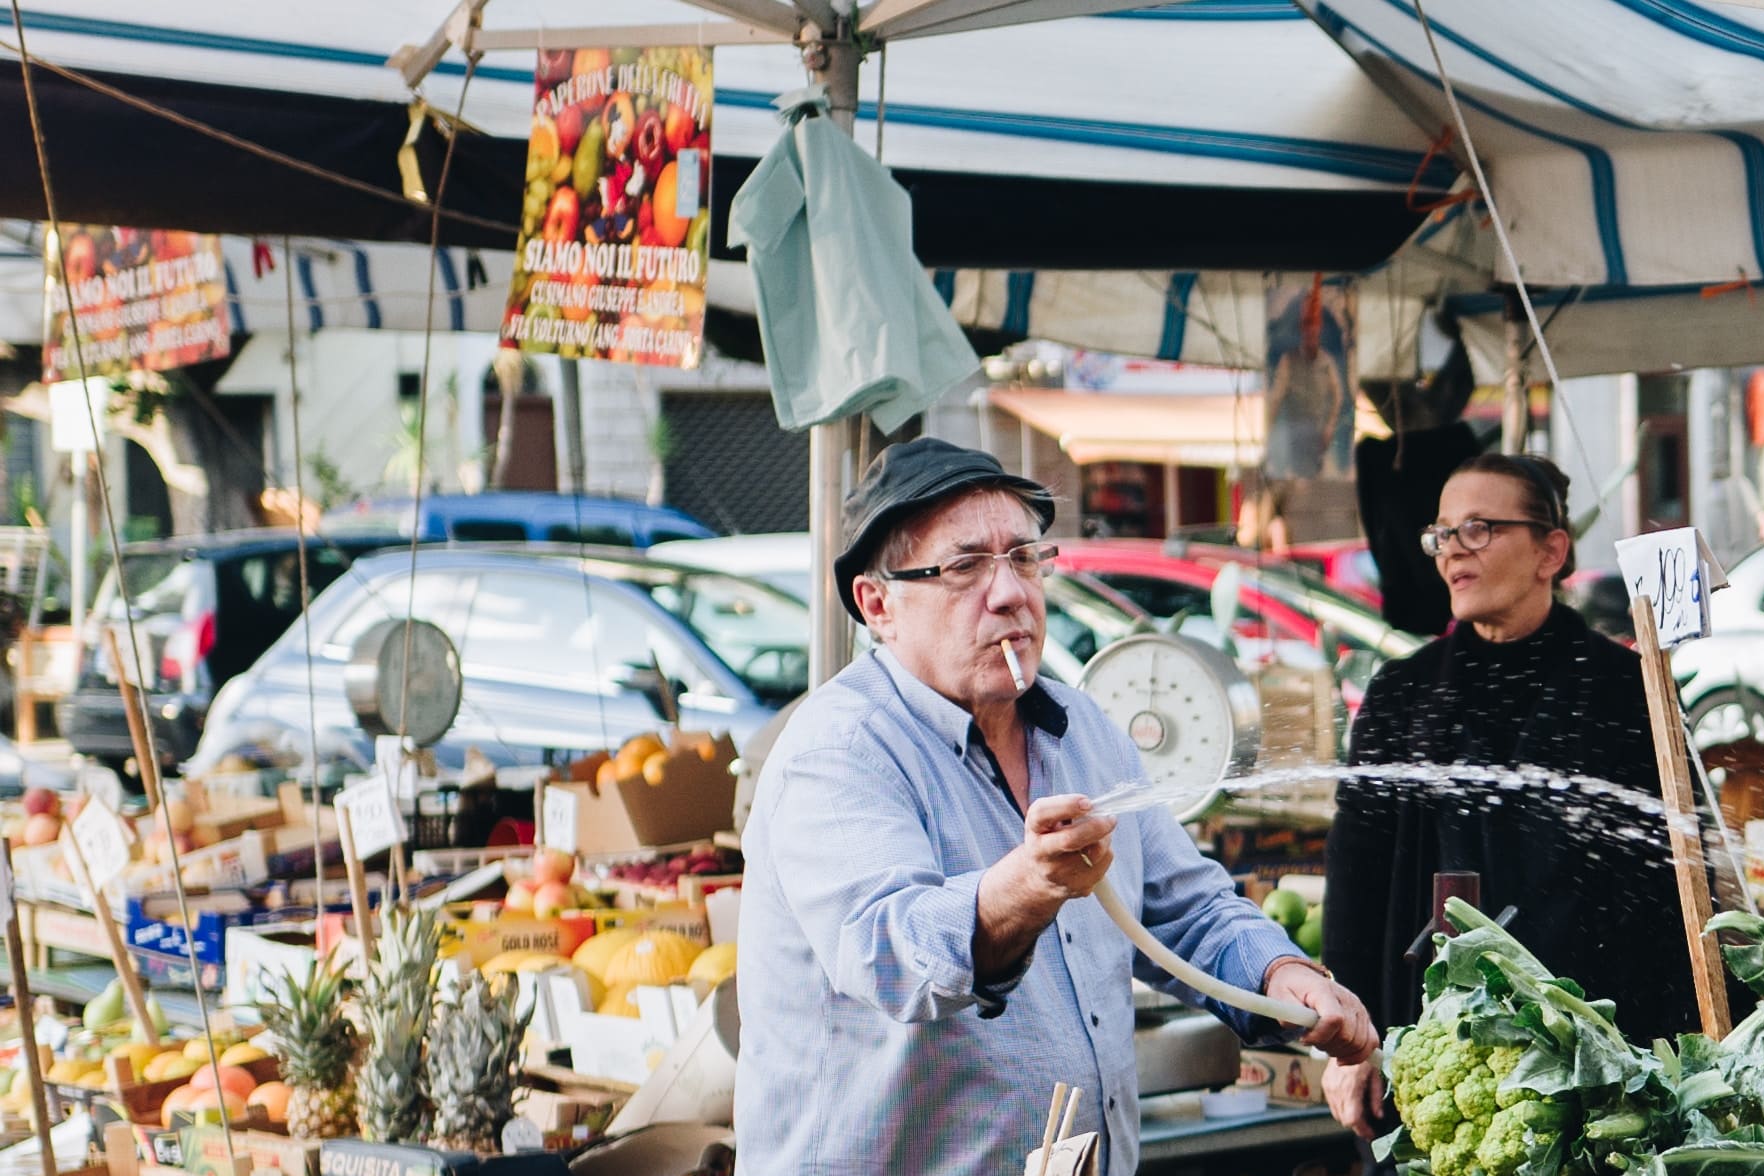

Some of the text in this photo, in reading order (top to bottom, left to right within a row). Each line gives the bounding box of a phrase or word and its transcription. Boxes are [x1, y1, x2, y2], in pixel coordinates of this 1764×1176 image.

[523, 239, 701, 283] SIAMO NOI IL FUTURO
[502, 932, 531, 951] GOLD
